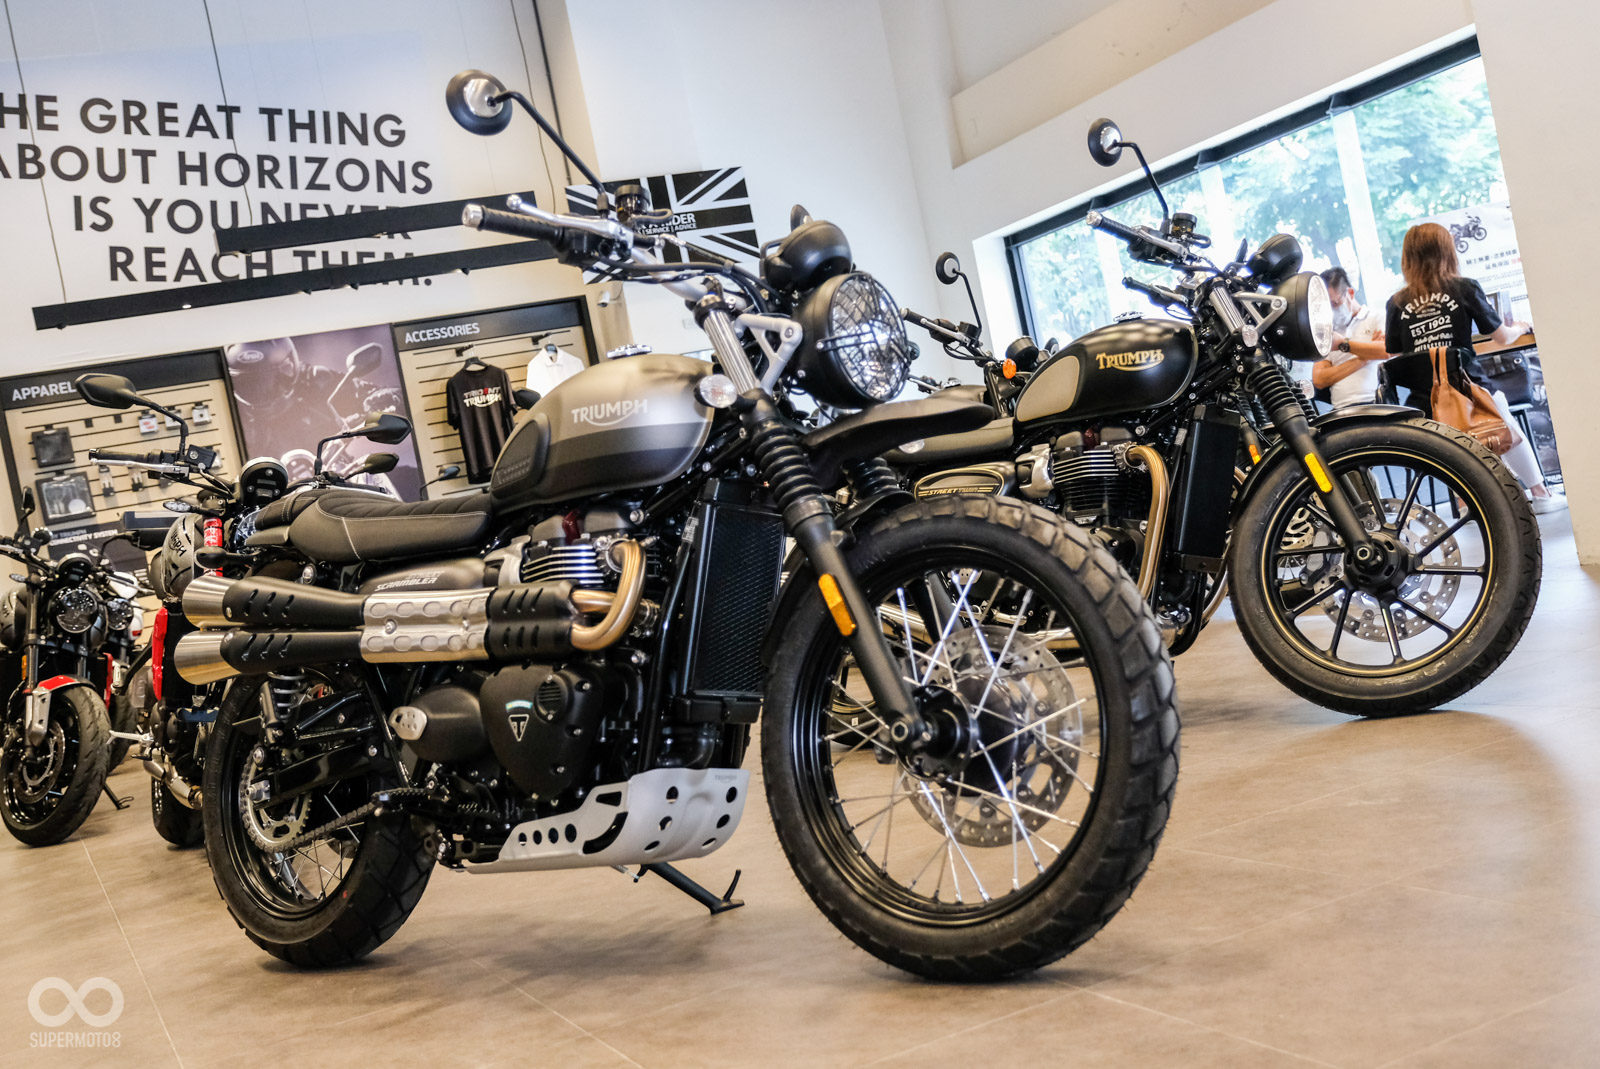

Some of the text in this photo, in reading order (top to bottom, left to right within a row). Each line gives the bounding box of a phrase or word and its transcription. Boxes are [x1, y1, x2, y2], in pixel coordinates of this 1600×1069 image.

[80, 97, 241, 140] GREAT
[258, 107, 407, 148] THING
[178, 151, 433, 195] HORIZONS
[74, 195, 114, 233] IS
[132, 197, 239, 234] YOU
[109, 245, 273, 283] REACH
[1400, 292, 1459, 320] TRIUMPH
[404, 322, 481, 344] ACCESSORIES
[1410, 315, 1451, 338] EST 1902
[1095, 348, 1165, 372] TRIUMPH
[12, 381, 77, 402] APPAREL
[463, 393, 502, 408] TRIUMPH
[571, 399, 649, 427] TRIUMPH
[928, 487, 959, 496] STREET
[374, 577, 438, 592] SCRAMBLER
